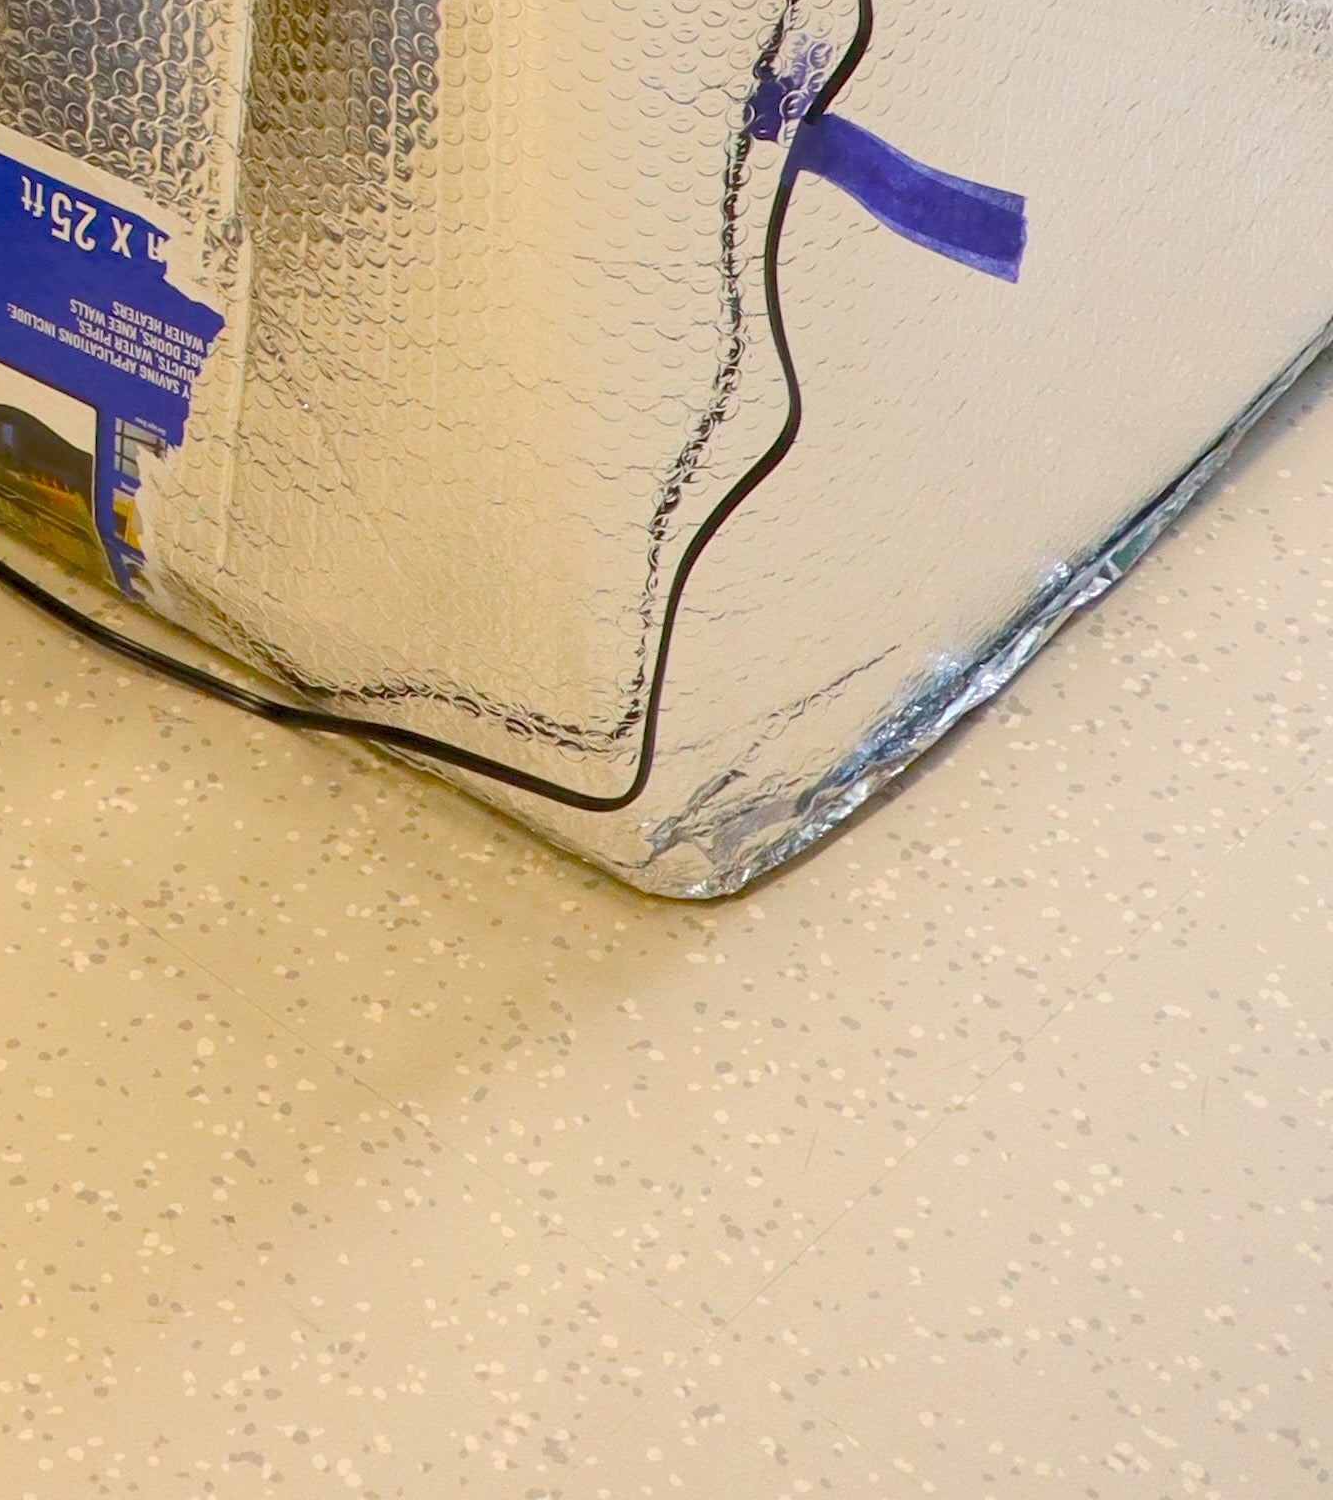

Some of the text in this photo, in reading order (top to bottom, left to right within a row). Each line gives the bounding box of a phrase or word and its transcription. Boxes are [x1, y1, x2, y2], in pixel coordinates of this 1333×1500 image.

[111, 217, 133, 258] X
[7, 303, 56, 337] INCLUDE:
[70, 299, 106, 327] WALLS
[109, 316, 137, 339] KNEE
[113, 302, 161, 332] HEATERS
[59, 329, 136, 373] APPLICATIONS
[77, 318, 195, 382] DUCTS, WATER PIPES,
[141, 329, 181, 360] DOORS,
[165, 324, 203, 352] WATER
[140, 366, 179, 393] SAVING
